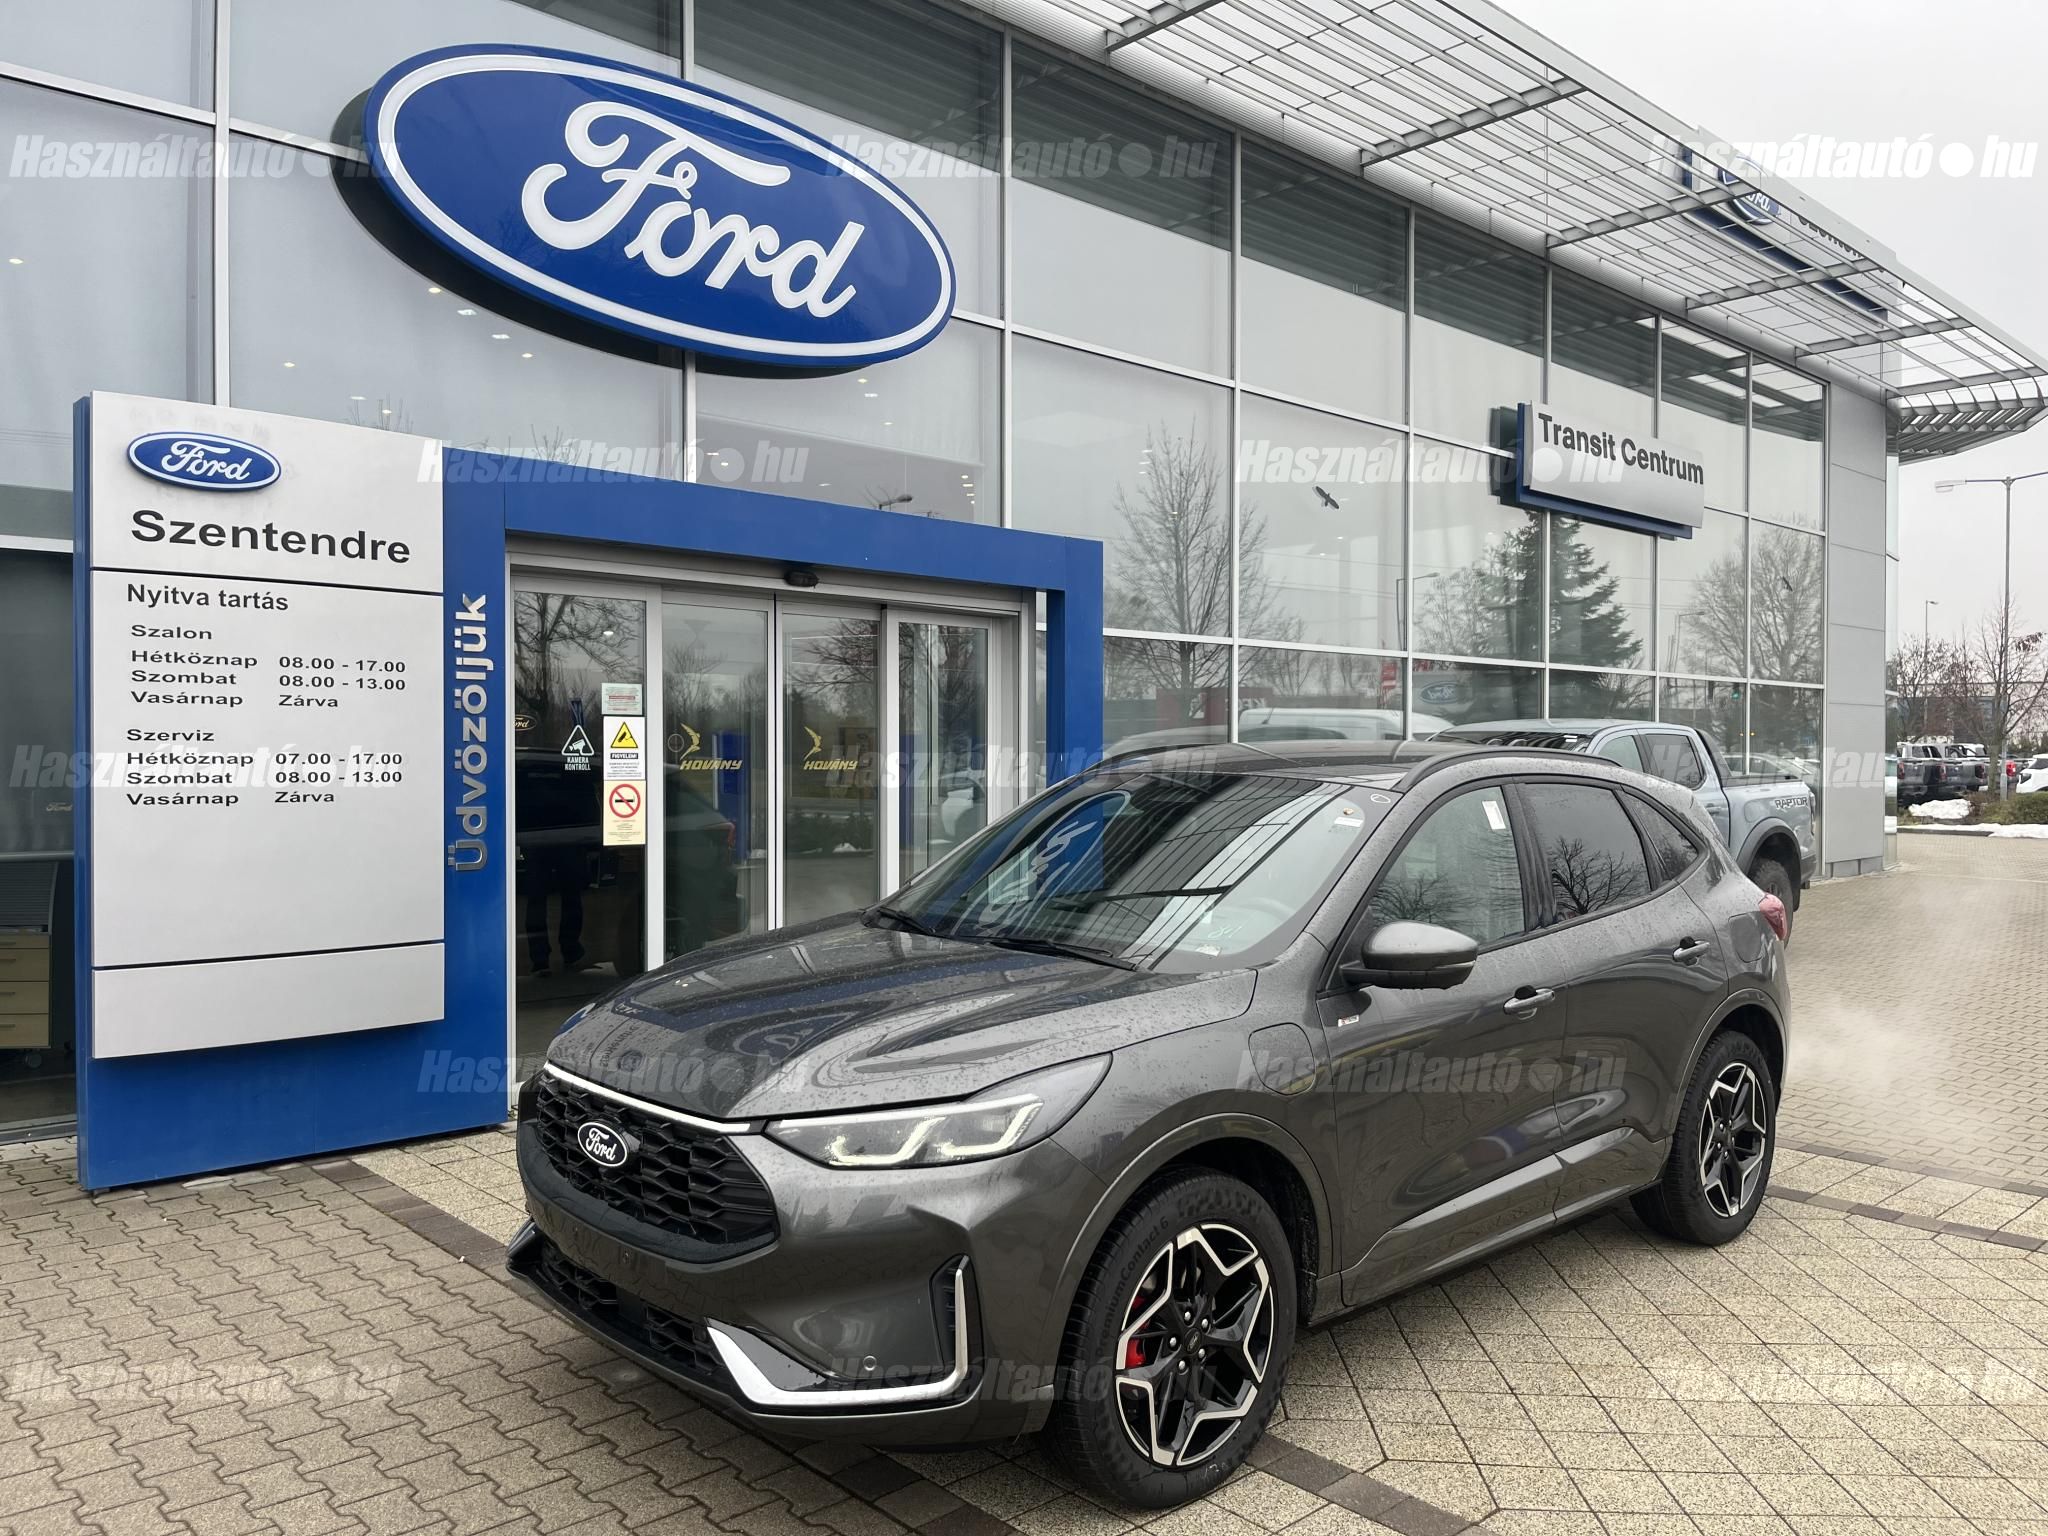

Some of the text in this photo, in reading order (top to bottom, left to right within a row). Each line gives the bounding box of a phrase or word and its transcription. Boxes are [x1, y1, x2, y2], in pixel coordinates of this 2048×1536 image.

[521, 101, 864, 318] Ford
[1538, 412, 1704, 485] Transit Centrum
[161, 440, 252, 481] Ford
[131, 509, 410, 564] Szentendre
[127, 583, 289, 611] Nyitva tartás
[131, 624, 212, 640] Szalon
[131, 650, 258, 668] Hétköznap
[279, 656, 335, 670] 08.00
[355, 659, 406, 673] 17.00
[131, 670, 237, 686] Szombat
[279, 674, 335, 688] 08.00
[355, 677, 406, 691] 13.00
[130, 690, 339, 708] Vasárnap Zárva
[127, 728, 215, 742] Szerviz
[448, 593, 494, 871] Üdvözöljük
[127, 752, 254, 767] Hétköznap
[275, 753, 331, 766] 07.00
[352, 753, 403, 766] 17.00
[803, 758, 858, 770] HOVÁNY
[127, 772, 233, 786] Szombat
[275, 771, 331, 784] 08.00
[352, 771, 403, 784] 13.00
[127, 790, 335, 807] Vasárnap Zárva
[1774, 796, 1807, 808] RAPTOR
[585, 1127, 617, 1161] Ford
